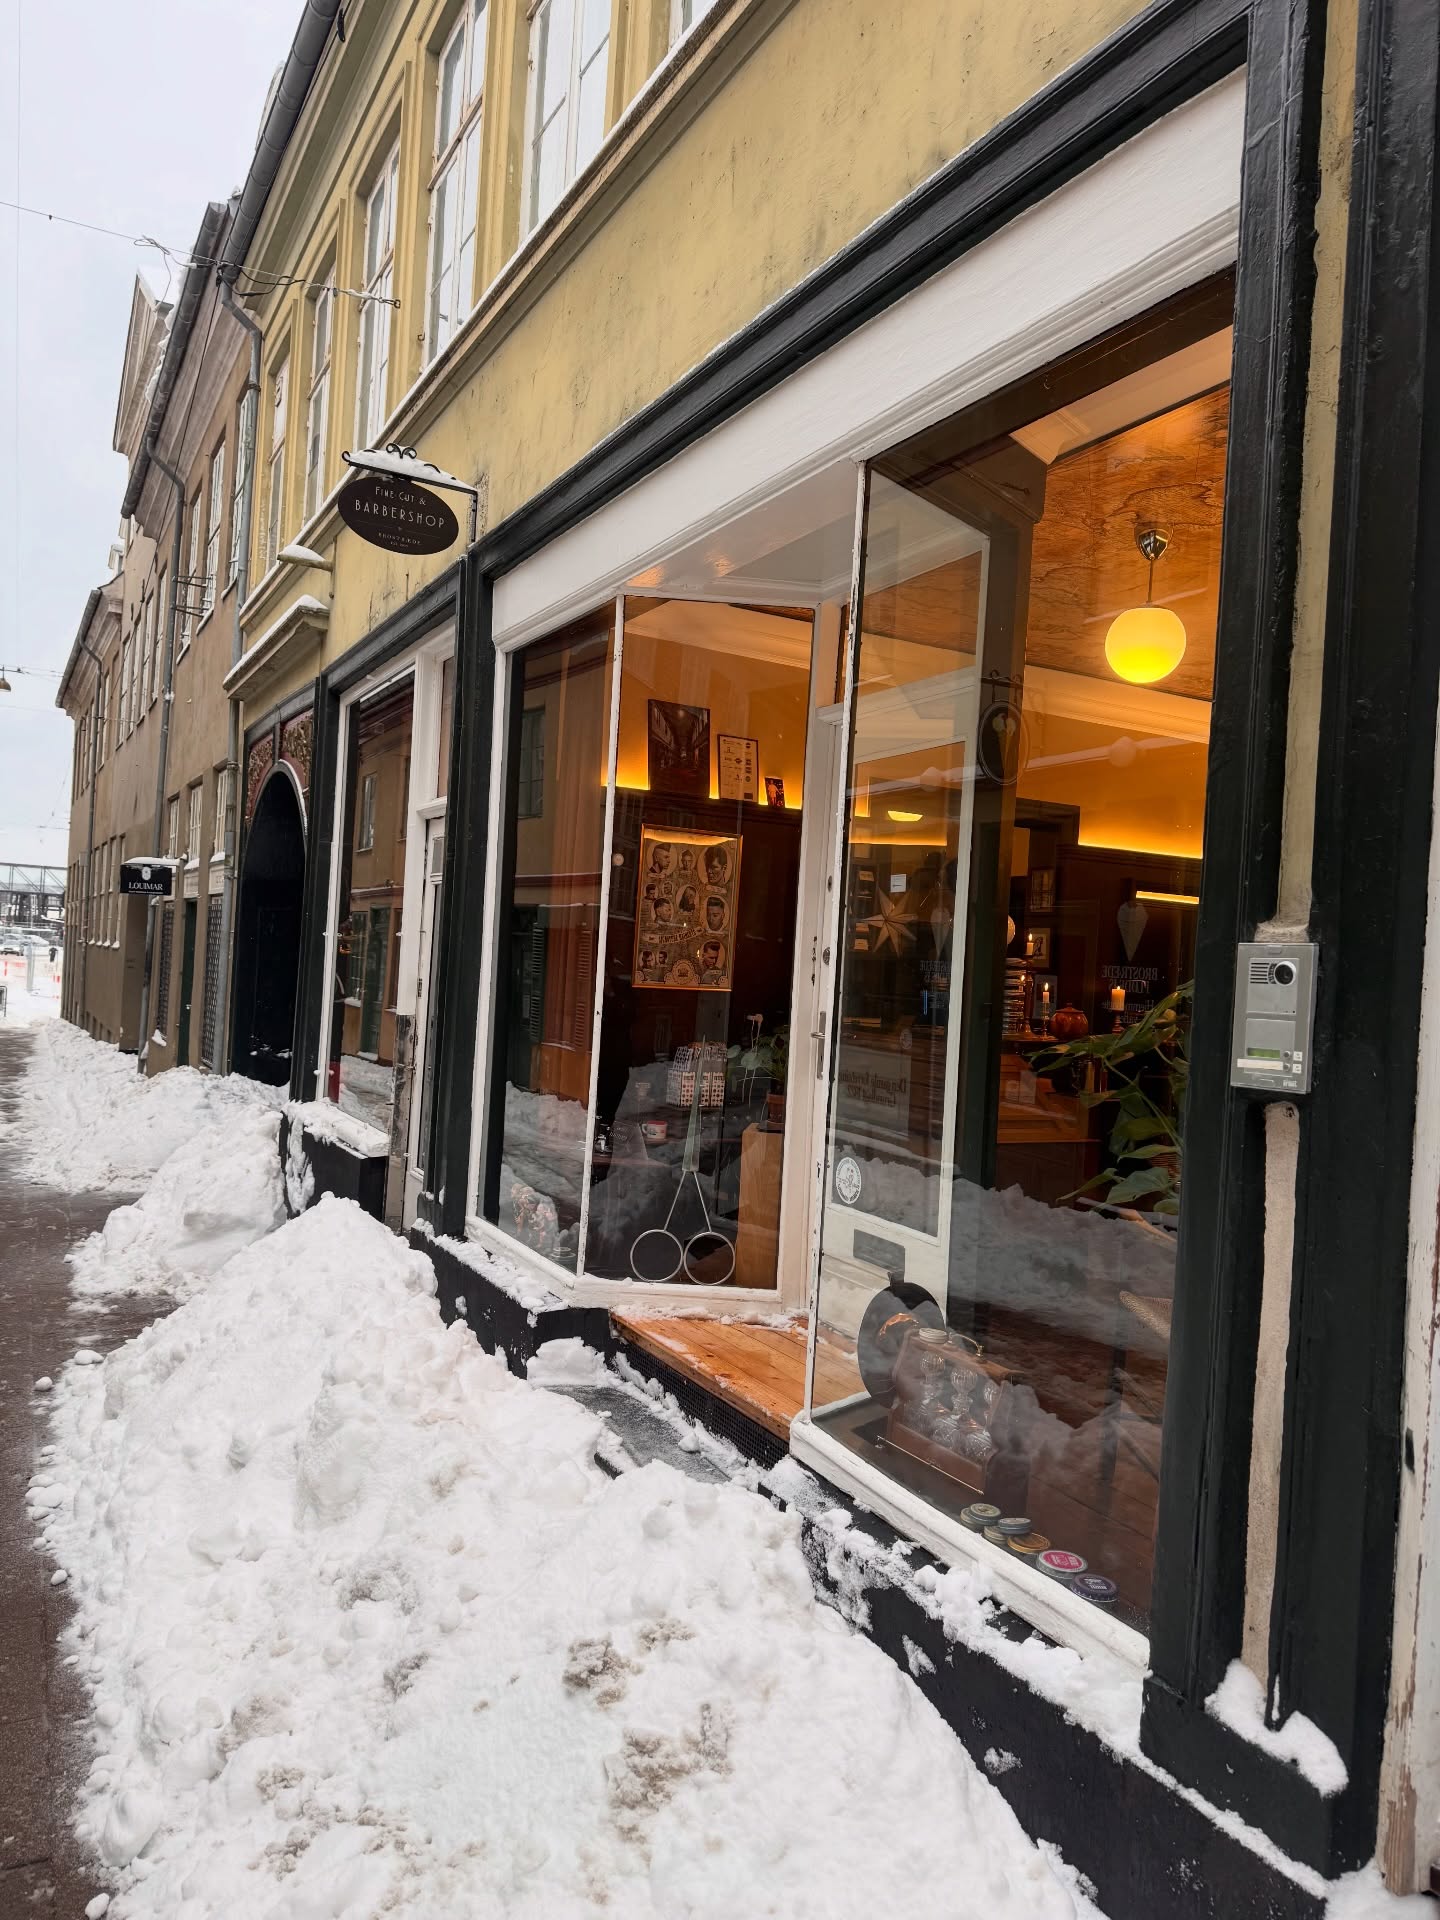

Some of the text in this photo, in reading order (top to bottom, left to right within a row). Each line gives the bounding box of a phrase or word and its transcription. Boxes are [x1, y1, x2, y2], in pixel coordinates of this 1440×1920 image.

[375, 486, 427, 506] FINE CUT &
[355, 499, 445, 528] BARBERSHOP
[128, 881, 164, 891] LOUIMAR
